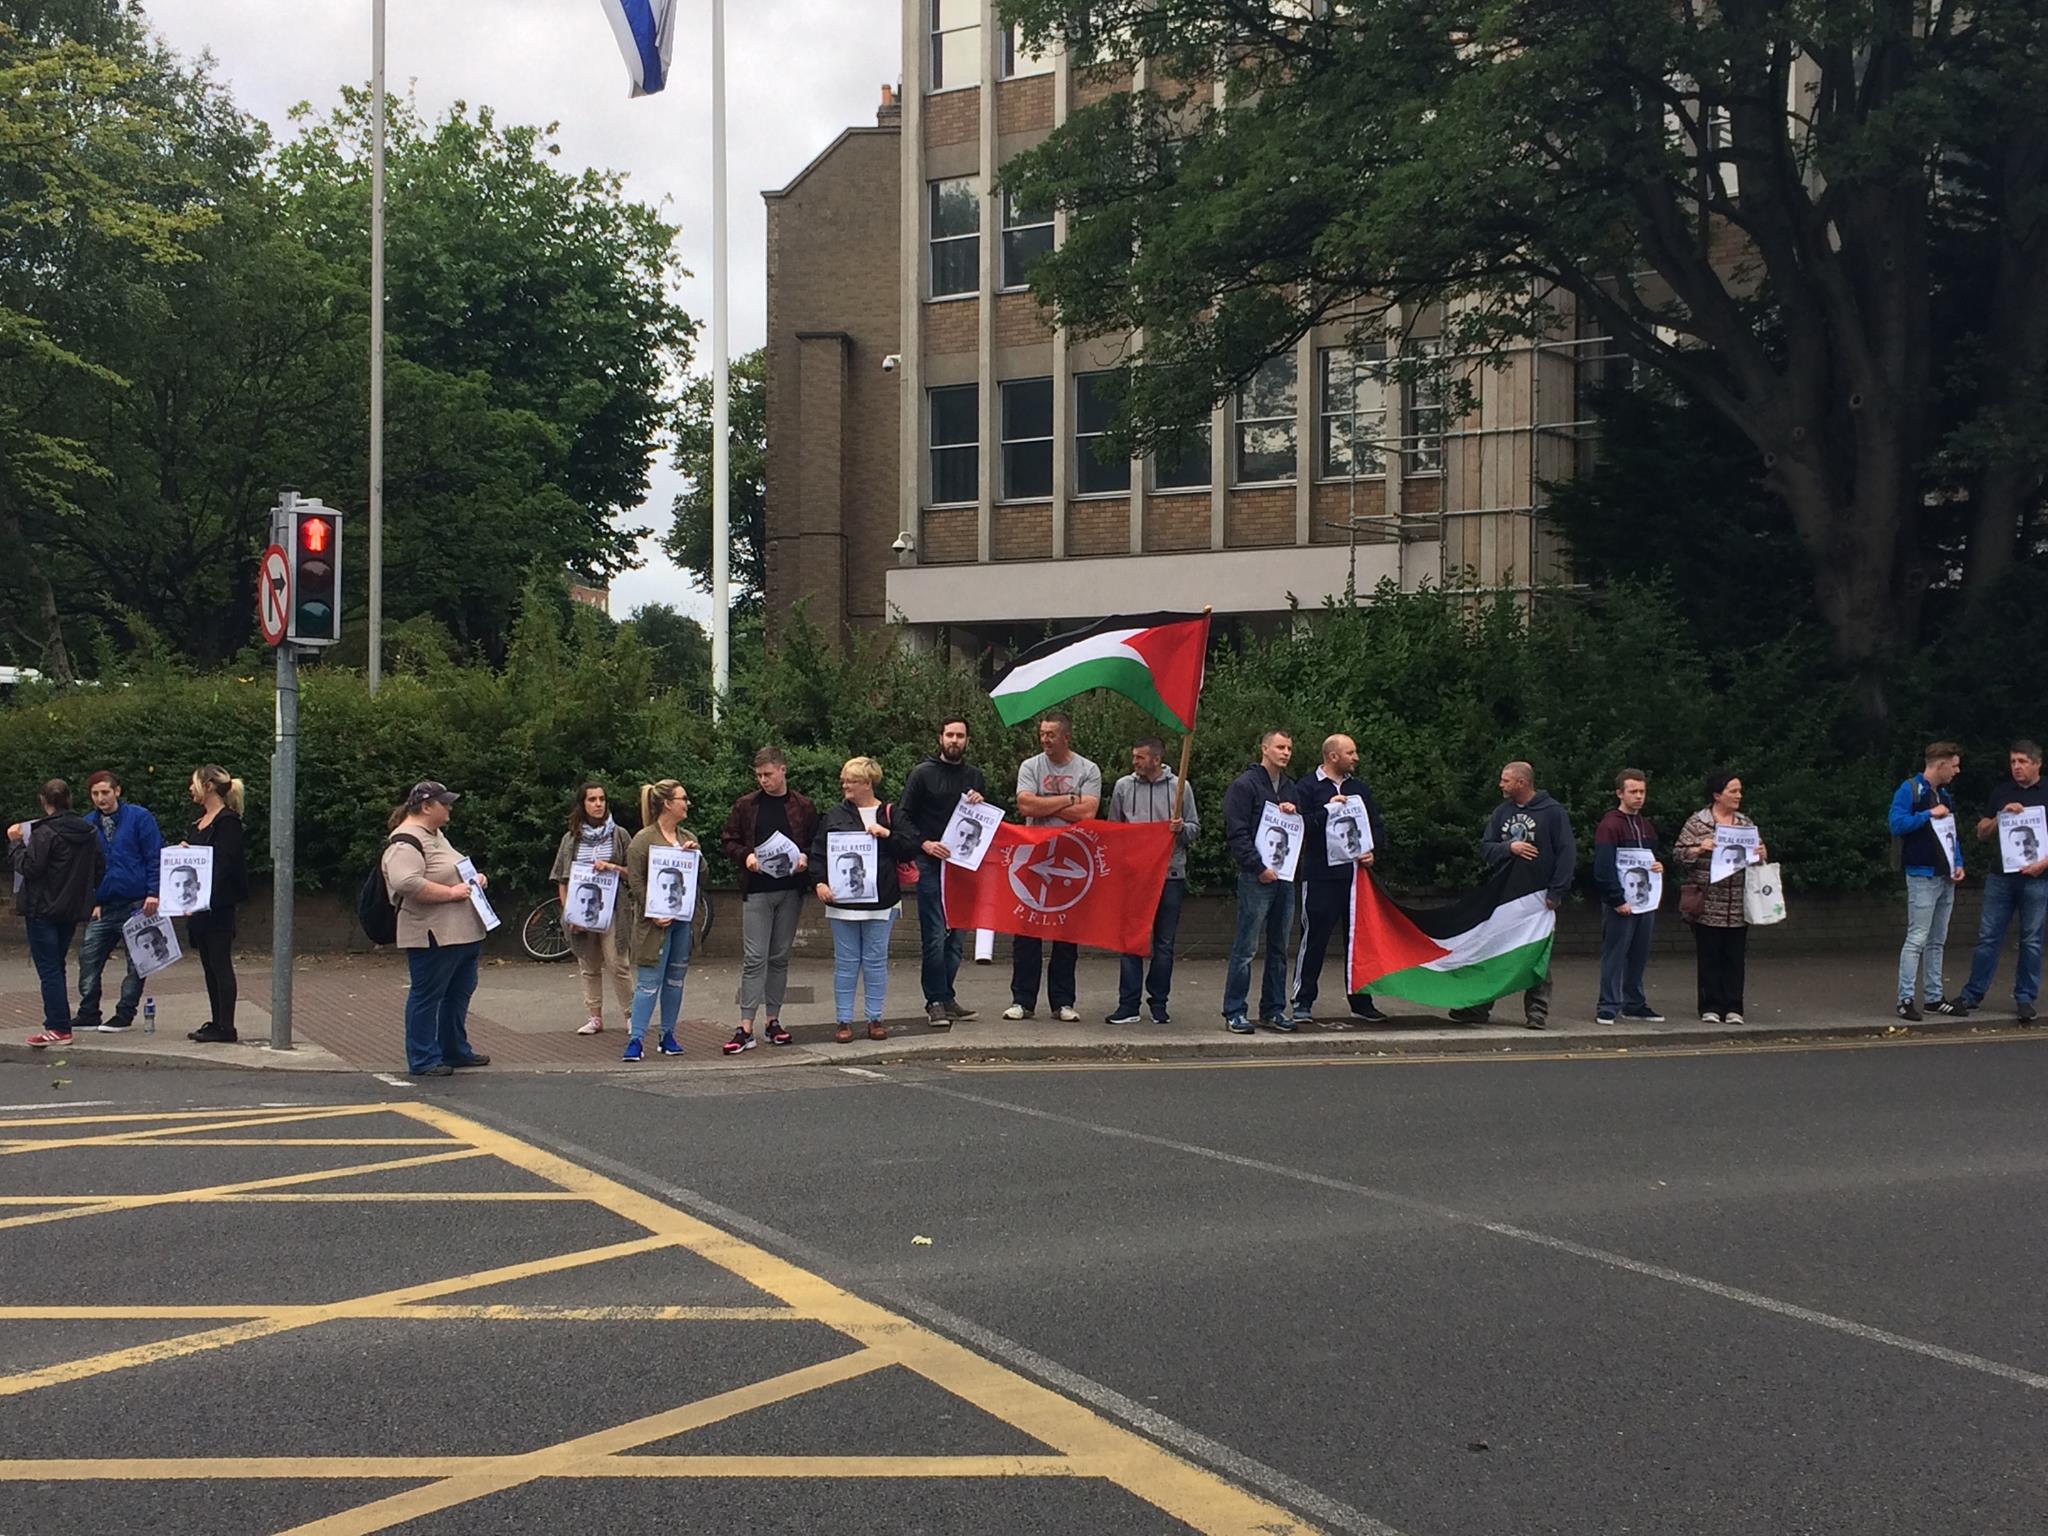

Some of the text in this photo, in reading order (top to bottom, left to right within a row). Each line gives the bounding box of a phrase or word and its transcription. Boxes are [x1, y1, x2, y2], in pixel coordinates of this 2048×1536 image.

[1264, 814, 1300, 832] BILAL KAYED
[1718, 836, 1756, 845] BILAL KAYED
[831, 843, 872, 852] BILAL KAYED
[163, 856, 207, 866] BILAL KAYED
[652, 858, 693, 869] BILAL KAYED
[591, 877, 613, 886] KAYED
